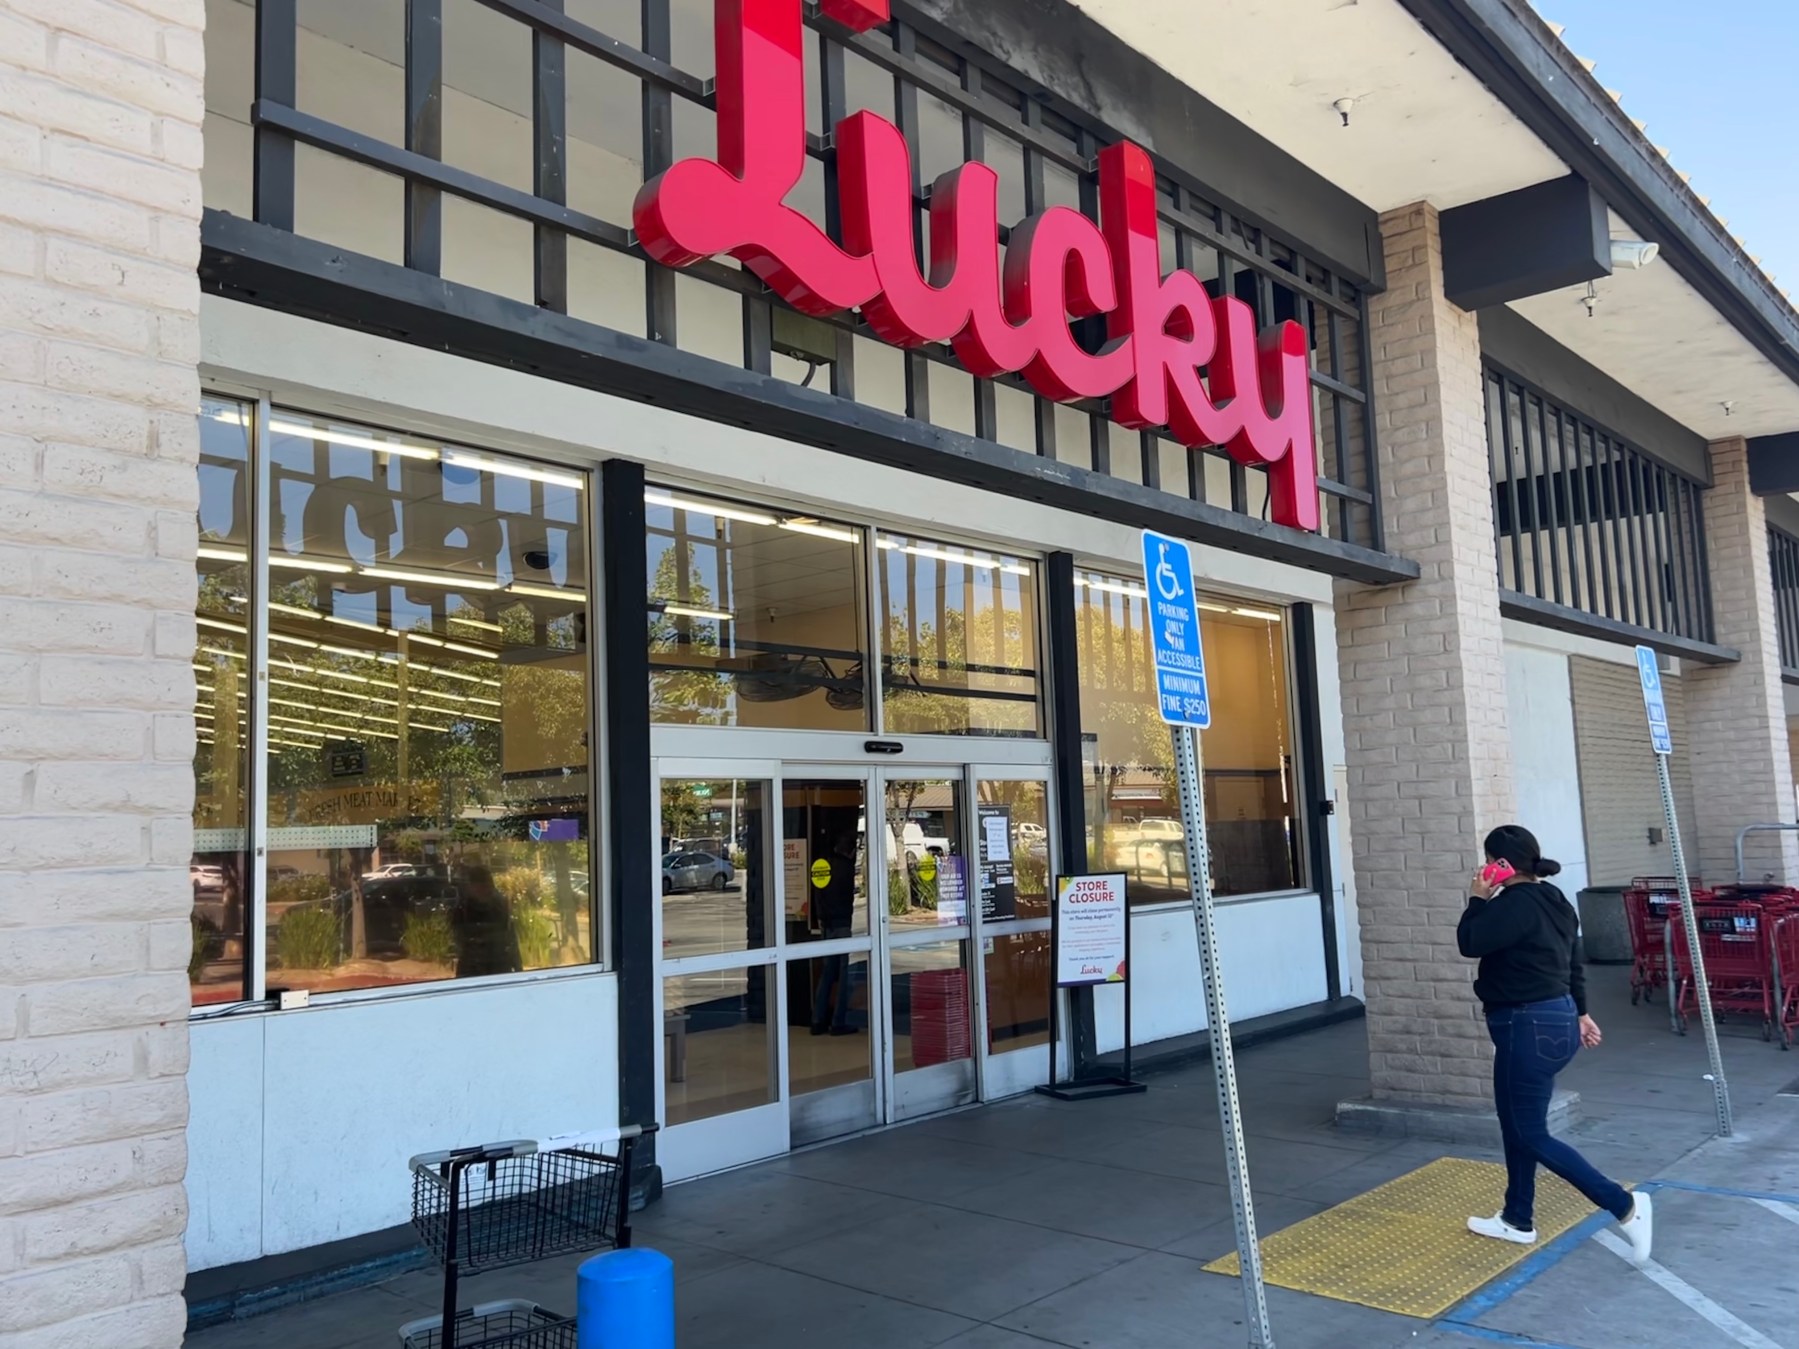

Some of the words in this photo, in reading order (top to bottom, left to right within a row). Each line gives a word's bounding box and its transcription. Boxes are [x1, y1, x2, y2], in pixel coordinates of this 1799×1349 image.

[633, 0, 1319, 531] Lucky
[1157, 601, 1189, 621] PARKING
[1165, 619, 1185, 636] ONLY
[1157, 648, 1201, 670] ACCESSIBLE
[1162, 674, 1201, 695] MINIMUM
[1161, 693, 1182, 712] FINE
[1183, 697, 1207, 716] $250
[343, 791, 373, 809] MEAT
[1075, 881, 1108, 892] STORE
[1069, 891, 1115, 904] CLOSURE
[1080, 963, 1103, 974] Lucky
